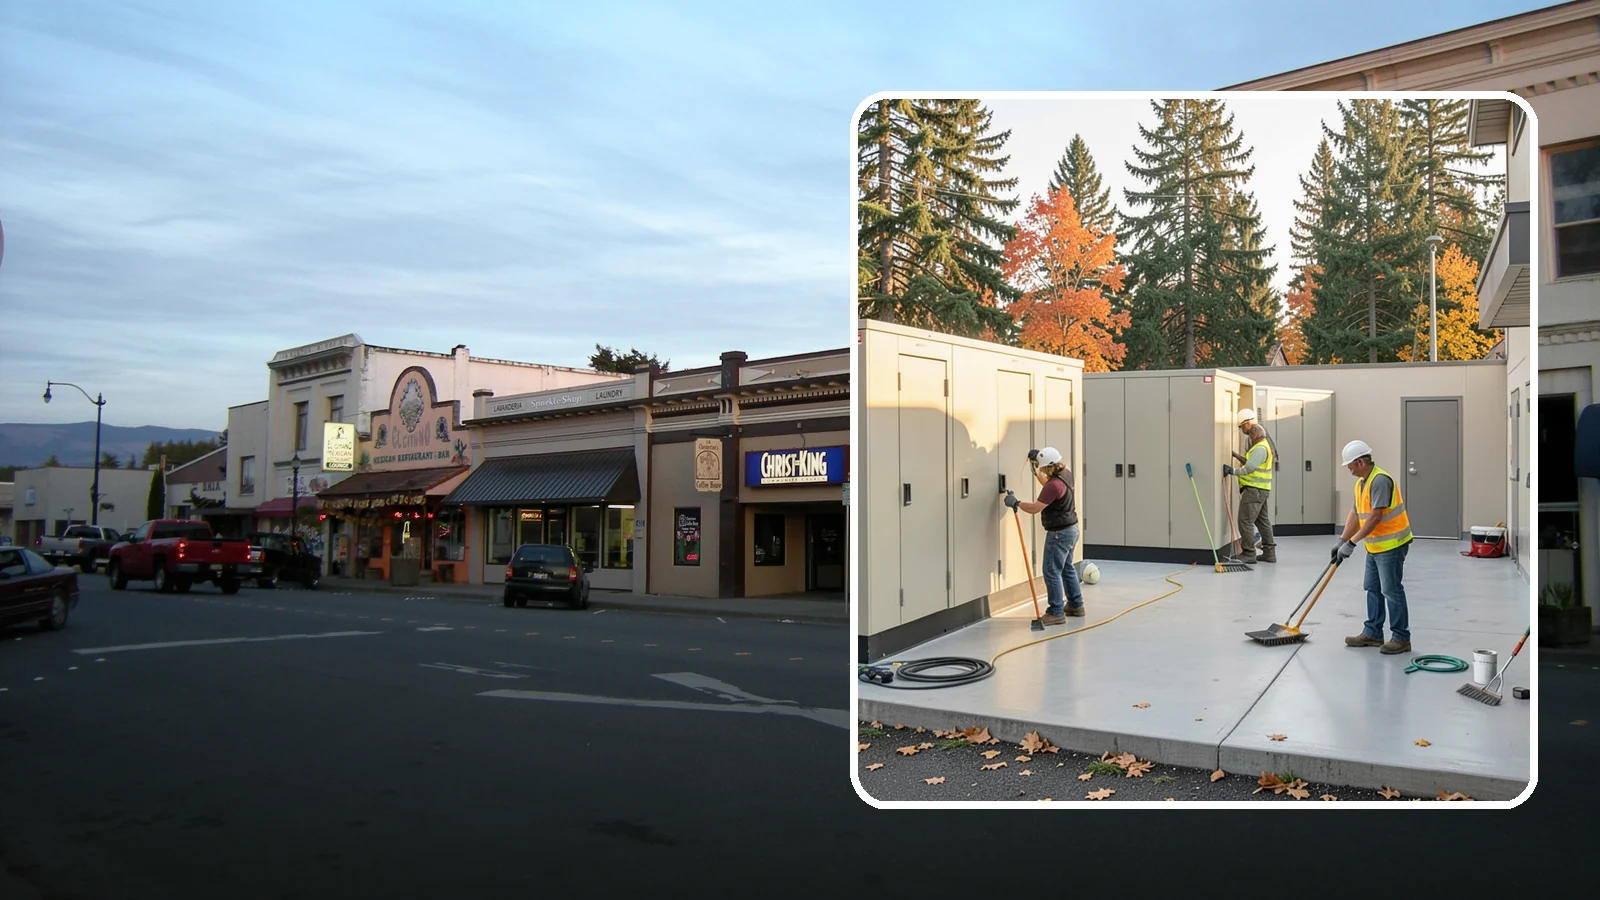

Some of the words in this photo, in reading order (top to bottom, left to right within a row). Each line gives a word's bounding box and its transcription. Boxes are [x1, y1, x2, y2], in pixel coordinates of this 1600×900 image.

[530, 396, 561, 409] Sparkle
[562, 394, 583, 404] Shop
[595, 389, 624, 400] LAUNDRY
[493, 402, 523, 412] LAVANDERIA
[373, 455, 396, 464] MEXICAN
[397, 451, 433, 462] RESTAURANT
[438, 450, 450, 459] BAR
[760, 452, 797, 478] CHRIST
[799, 450, 828, 476] KING
